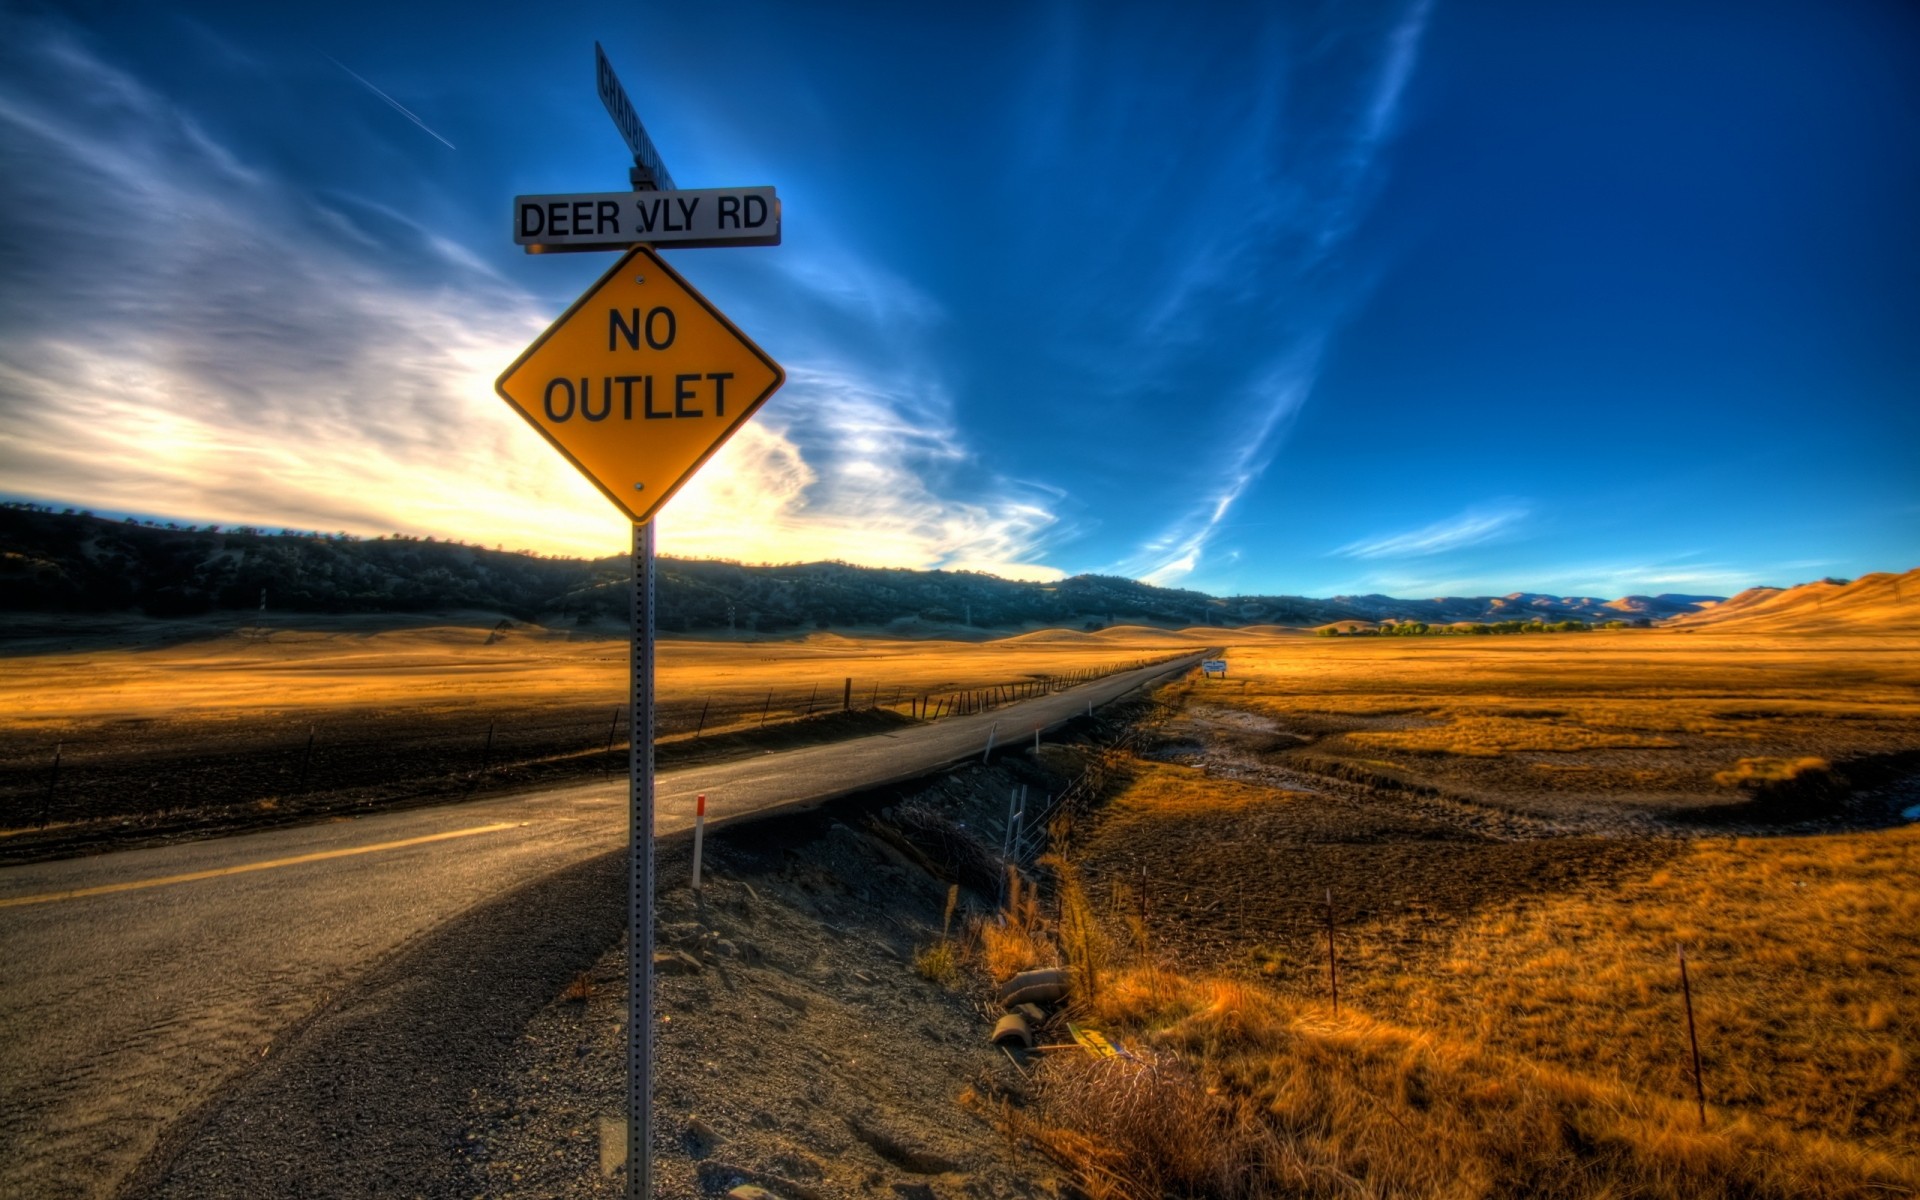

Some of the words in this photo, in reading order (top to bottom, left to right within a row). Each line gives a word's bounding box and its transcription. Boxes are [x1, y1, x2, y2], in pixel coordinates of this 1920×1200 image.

[521, 201, 620, 237] DEER
[637, 197, 699, 232] VLY
[718, 194, 768, 229] RD
[608, 306, 676, 352] NO
[543, 372, 734, 423] OUTLET
